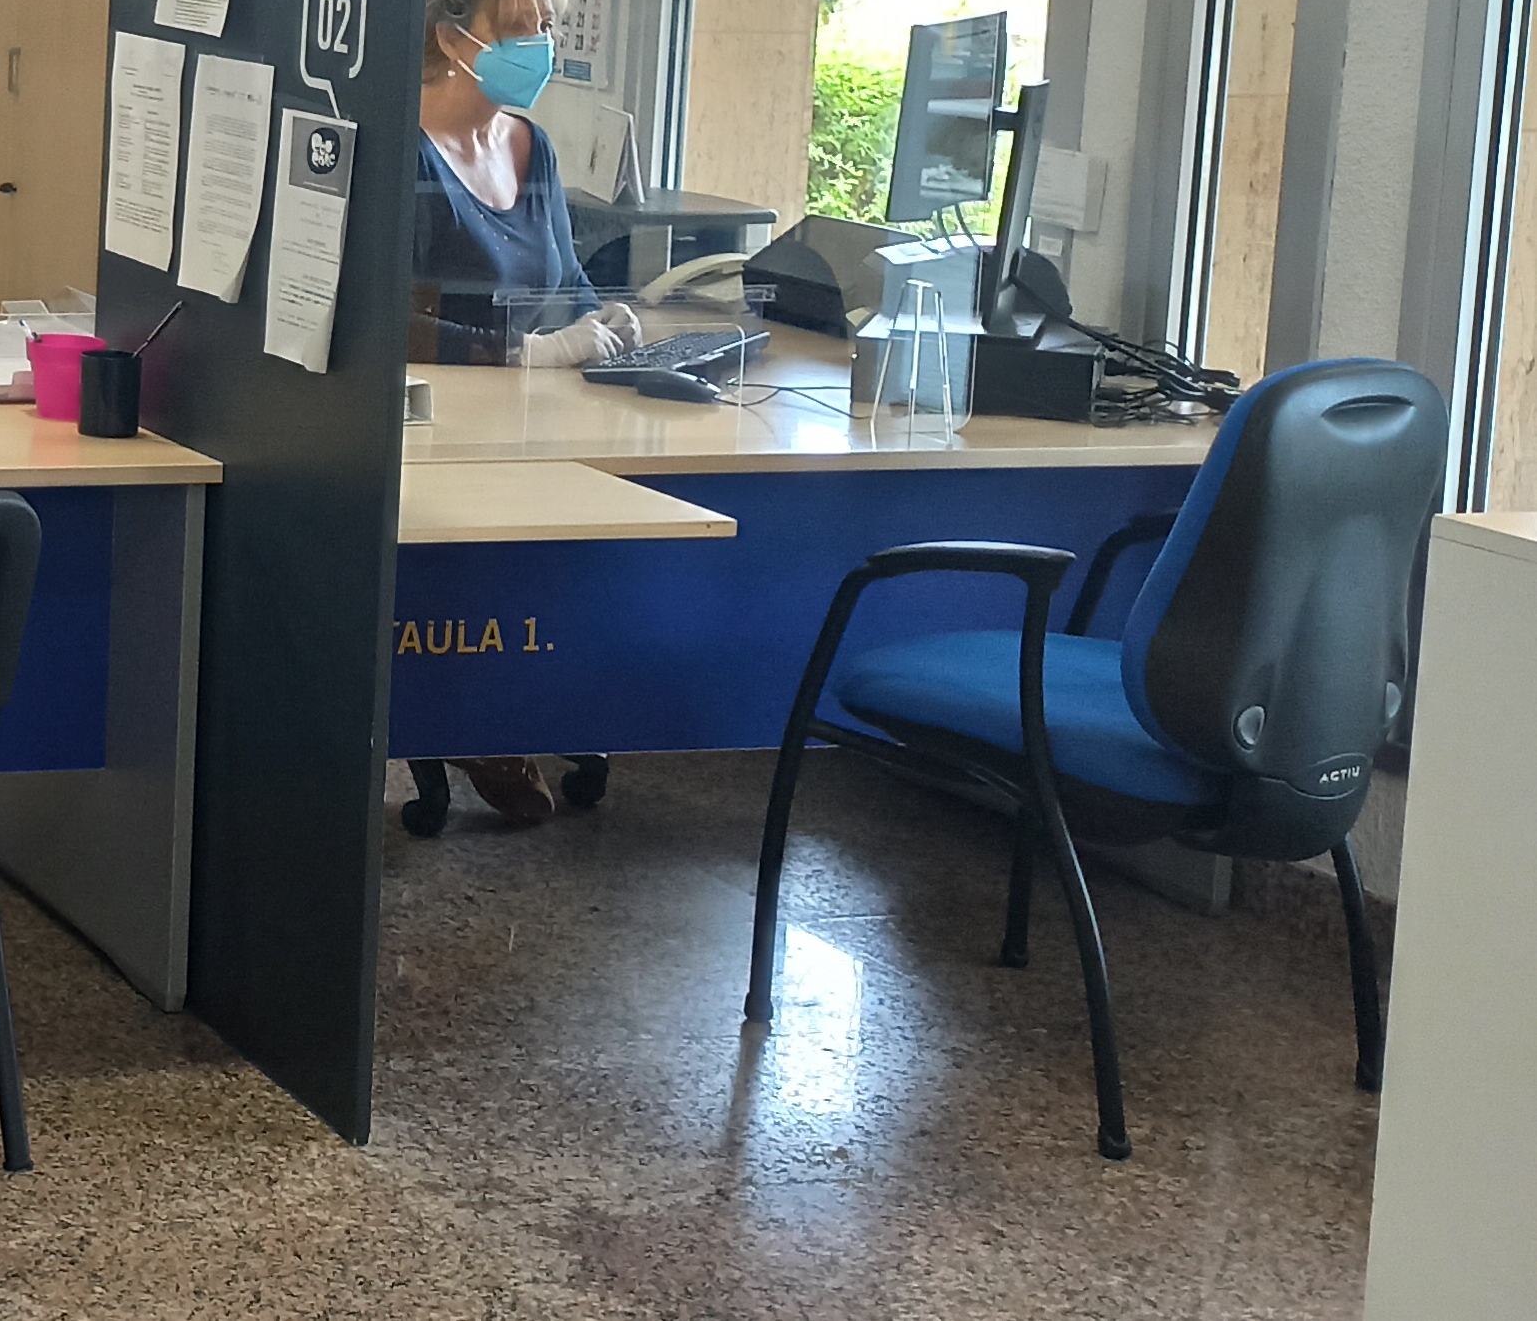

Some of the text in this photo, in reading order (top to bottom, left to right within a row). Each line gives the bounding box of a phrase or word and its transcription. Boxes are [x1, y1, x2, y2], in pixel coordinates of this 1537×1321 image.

[393, 617, 553, 655] AULA 1.
[1320, 766, 1359, 783] ACTIU
